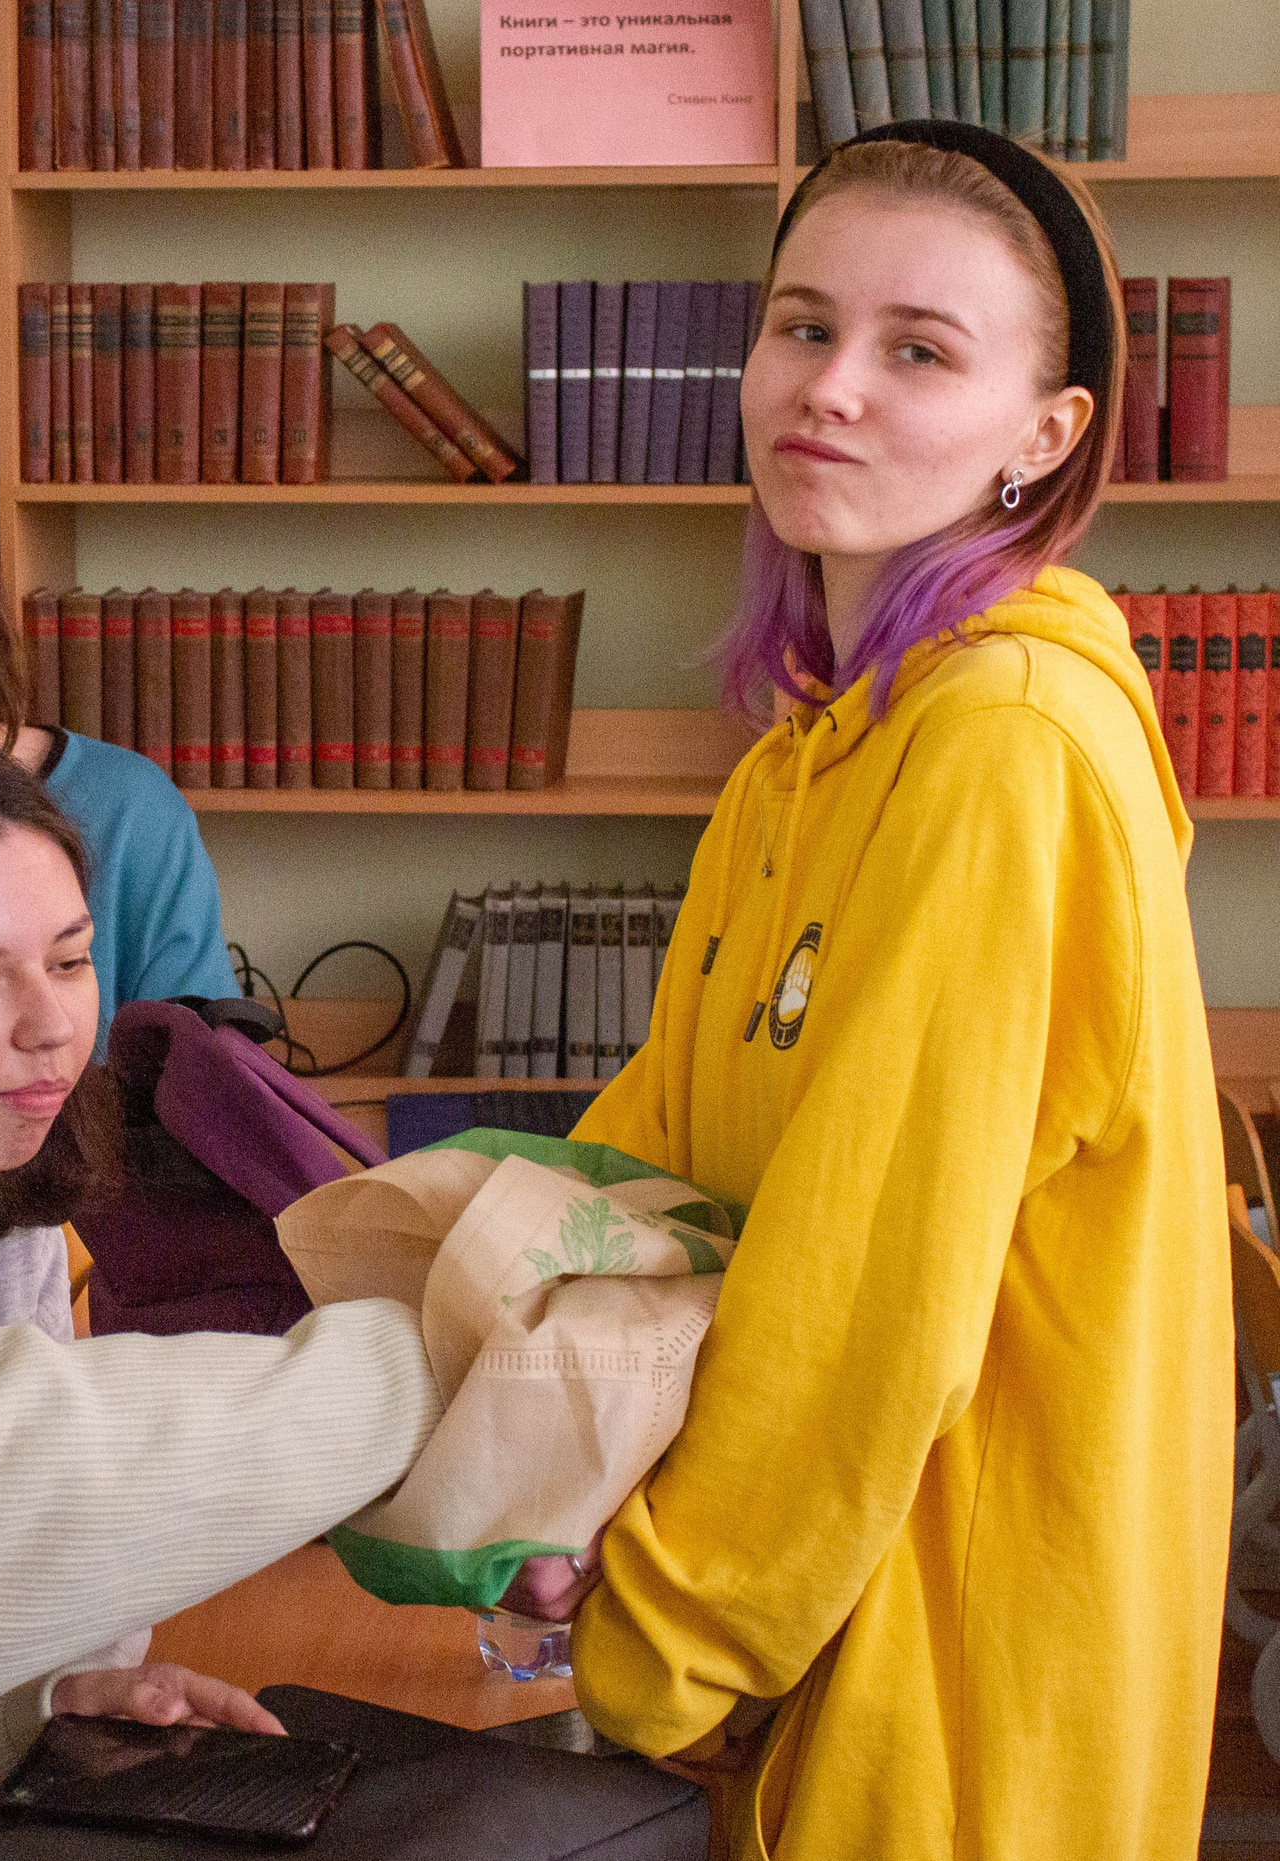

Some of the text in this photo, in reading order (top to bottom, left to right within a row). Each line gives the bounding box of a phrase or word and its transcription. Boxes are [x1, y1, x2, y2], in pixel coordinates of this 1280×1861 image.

[500, 15, 557, 29] Книги
[580, 14, 610, 27] это
[616, 13, 733, 29] уникальная
[500, 40, 696, 60] портативная магия.
[668, 93, 754, 105] Стивен Кинг
